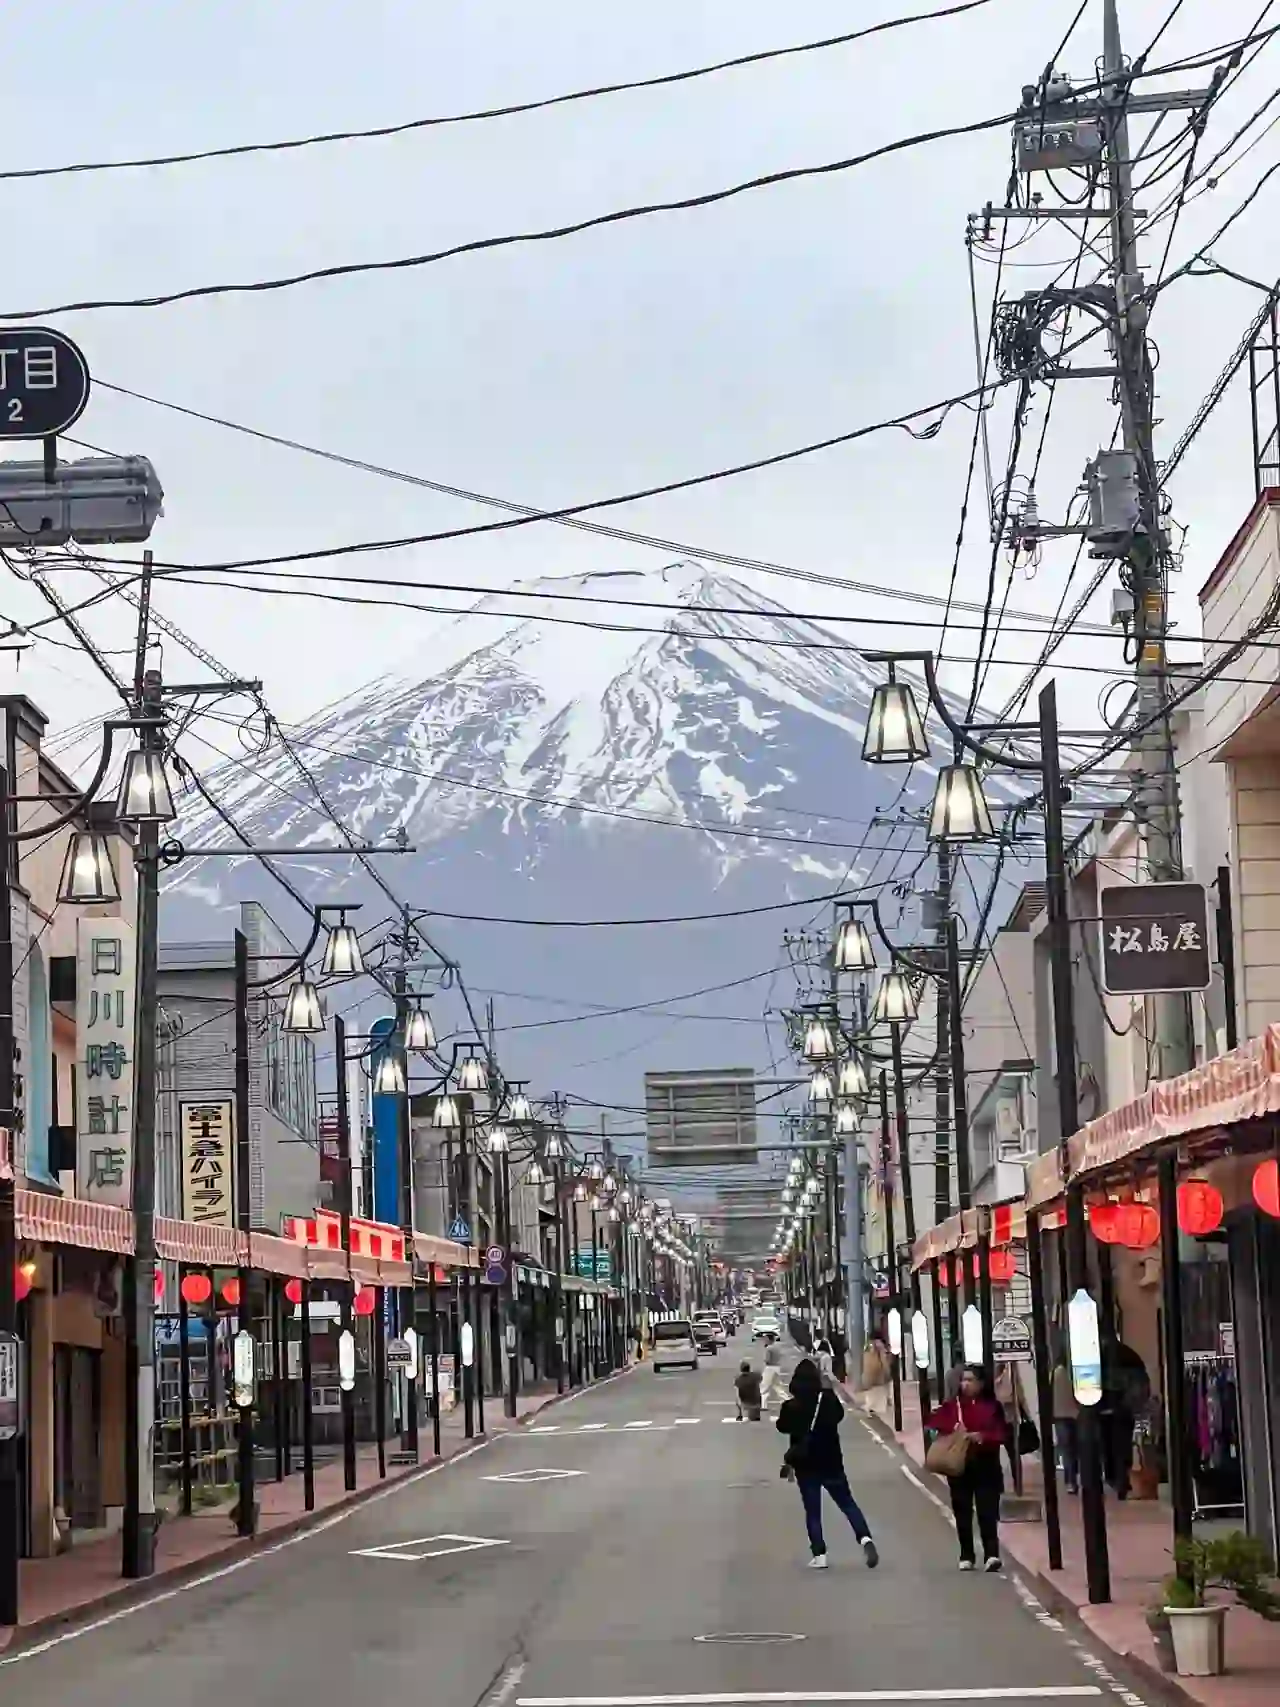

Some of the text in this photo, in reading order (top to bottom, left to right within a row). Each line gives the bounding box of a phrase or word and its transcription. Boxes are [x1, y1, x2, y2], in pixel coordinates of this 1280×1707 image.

[7, 398, 24, 421] 2
[1108, 921, 1202, 954] 松島屋
[86, 937, 128, 1190] 日川時計店
[187, 1105, 228, 1225] 富士急ハイラン
